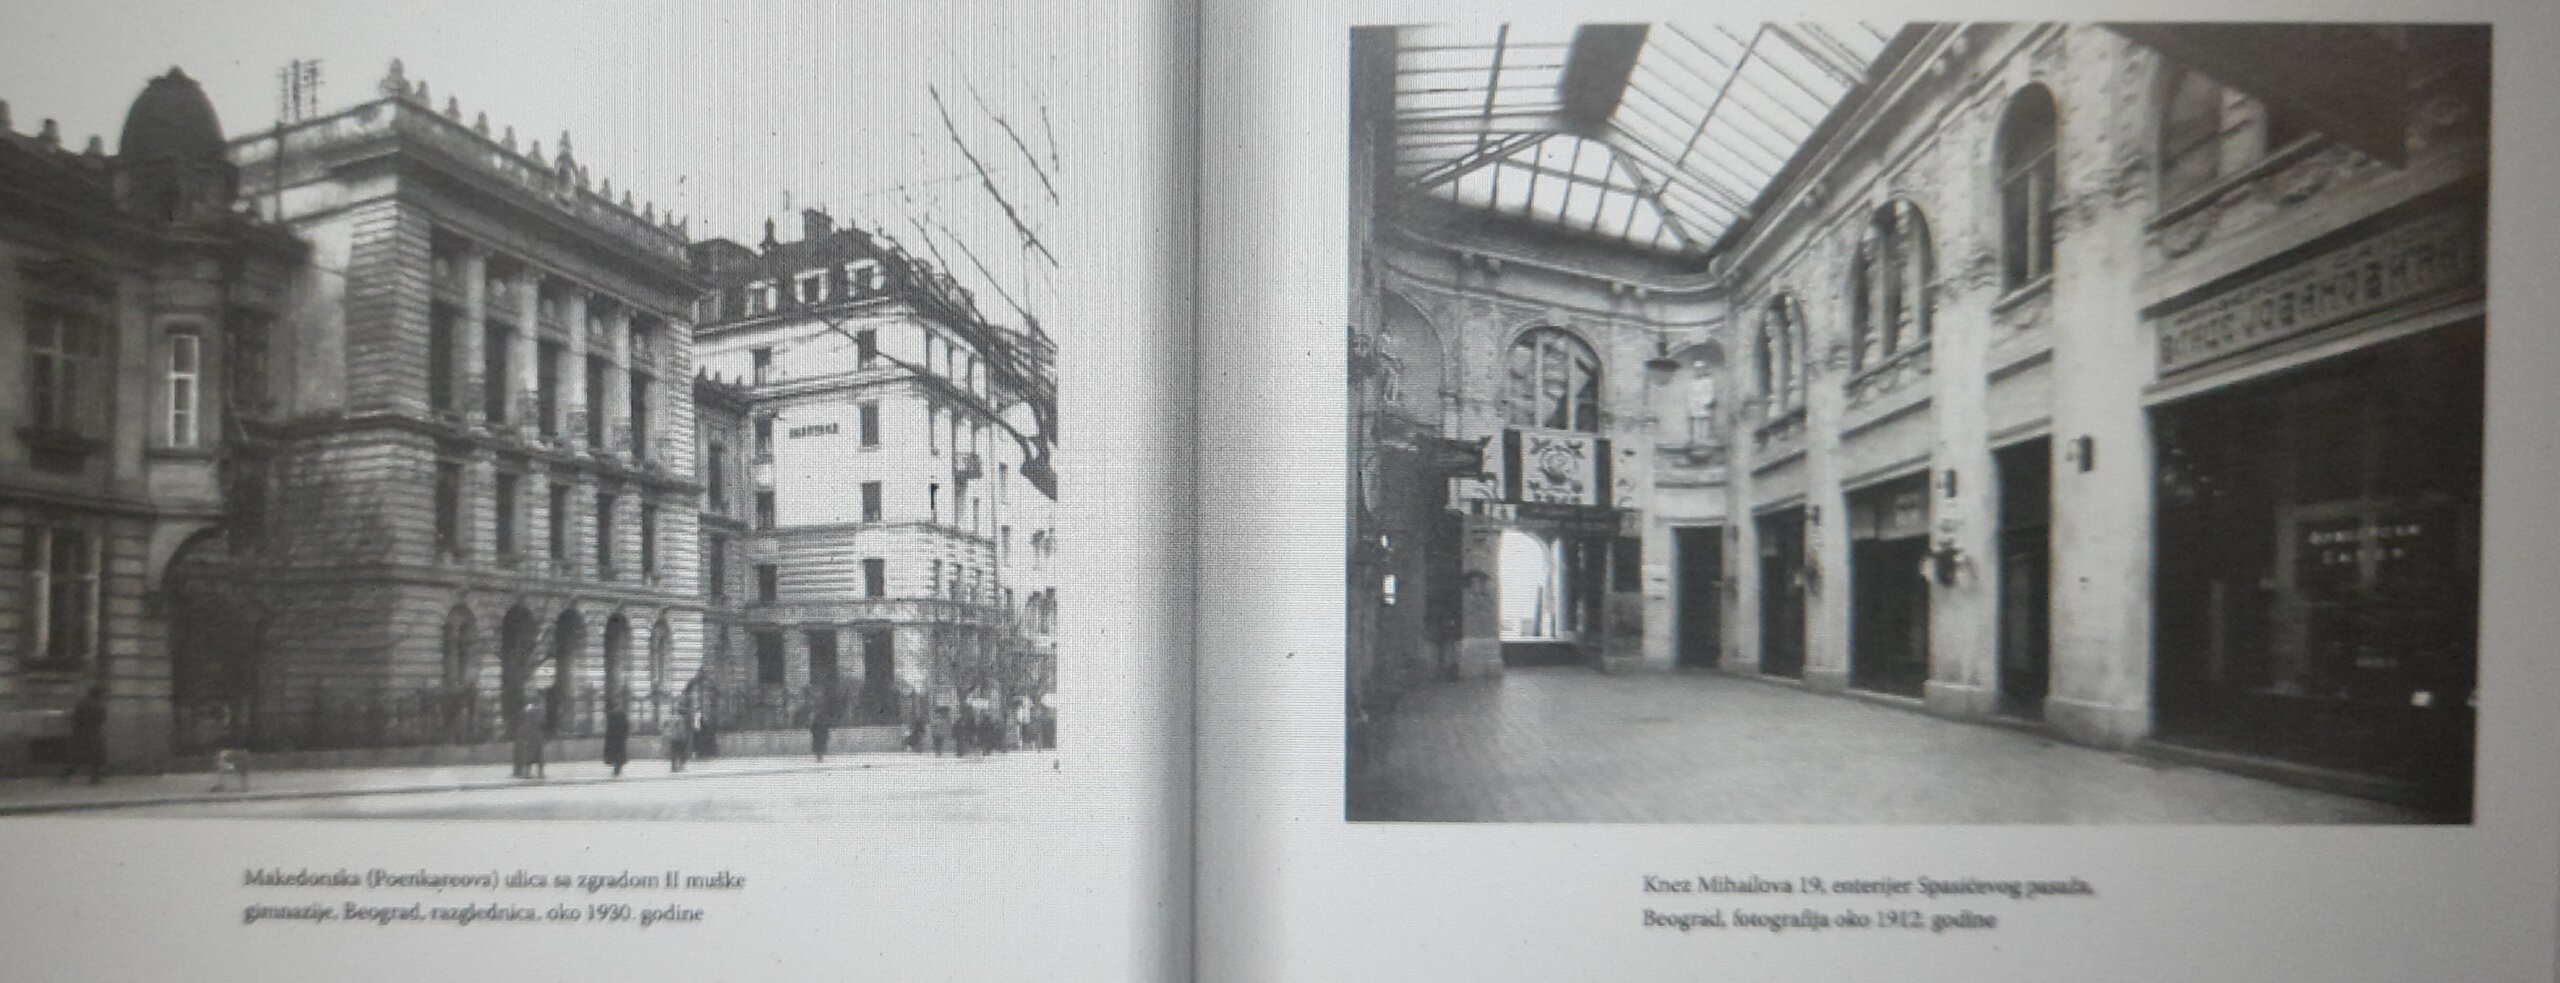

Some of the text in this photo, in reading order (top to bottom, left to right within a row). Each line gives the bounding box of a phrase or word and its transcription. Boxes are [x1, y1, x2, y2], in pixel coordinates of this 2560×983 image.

[243, 868, 362, 887] Makedonska
[366, 869, 499, 891] (Poenkareova)
[505, 869, 548, 889] ulica
[553, 875, 572, 889] sa
[577, 870, 660, 893] zgradom
[685, 870, 746, 890] muške
[1643, 874, 1692, 894] Knez
[1698, 875, 1794, 894] Mihailova
[1832, 878, 1912, 897] enterijer
[546, 904, 582, 922] oko
[639, 905, 704, 928] godine
[1732, 909, 1831, 932] fotografija
[1834, 909, 1872, 927] oko
[1930, 910, 1997, 933] godine
